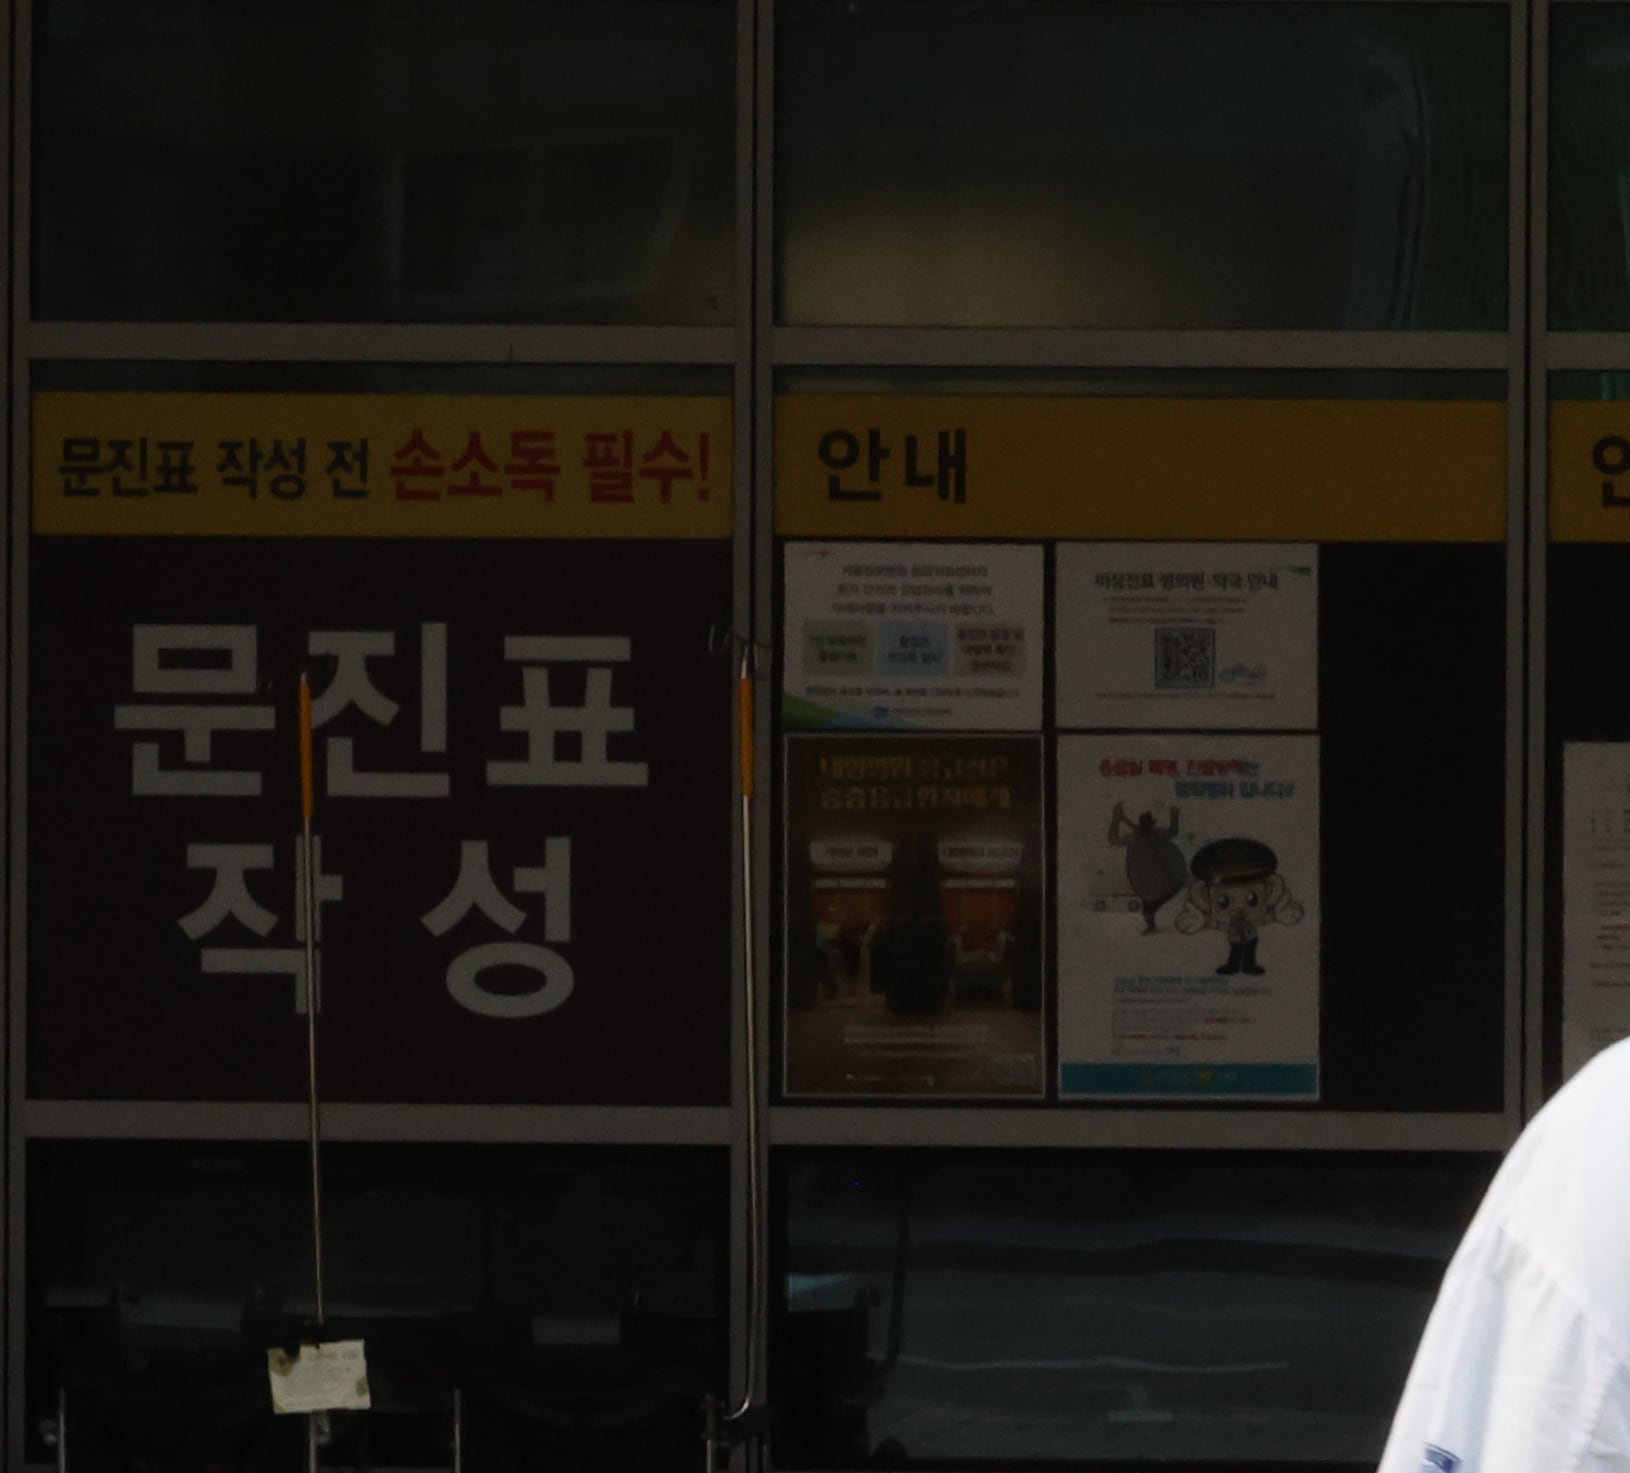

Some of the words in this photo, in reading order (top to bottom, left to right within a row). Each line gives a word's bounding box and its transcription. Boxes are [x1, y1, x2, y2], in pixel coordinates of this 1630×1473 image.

[58, 436, 199, 499] 문진표
[217, 437, 308, 500] 작성
[325, 437, 370, 499] 전
[389, 430, 560, 503] 손소독
[582, 430, 711, 503] 필수!
[817, 428, 968, 503] 안내
[113, 620, 649, 799] 문진표
